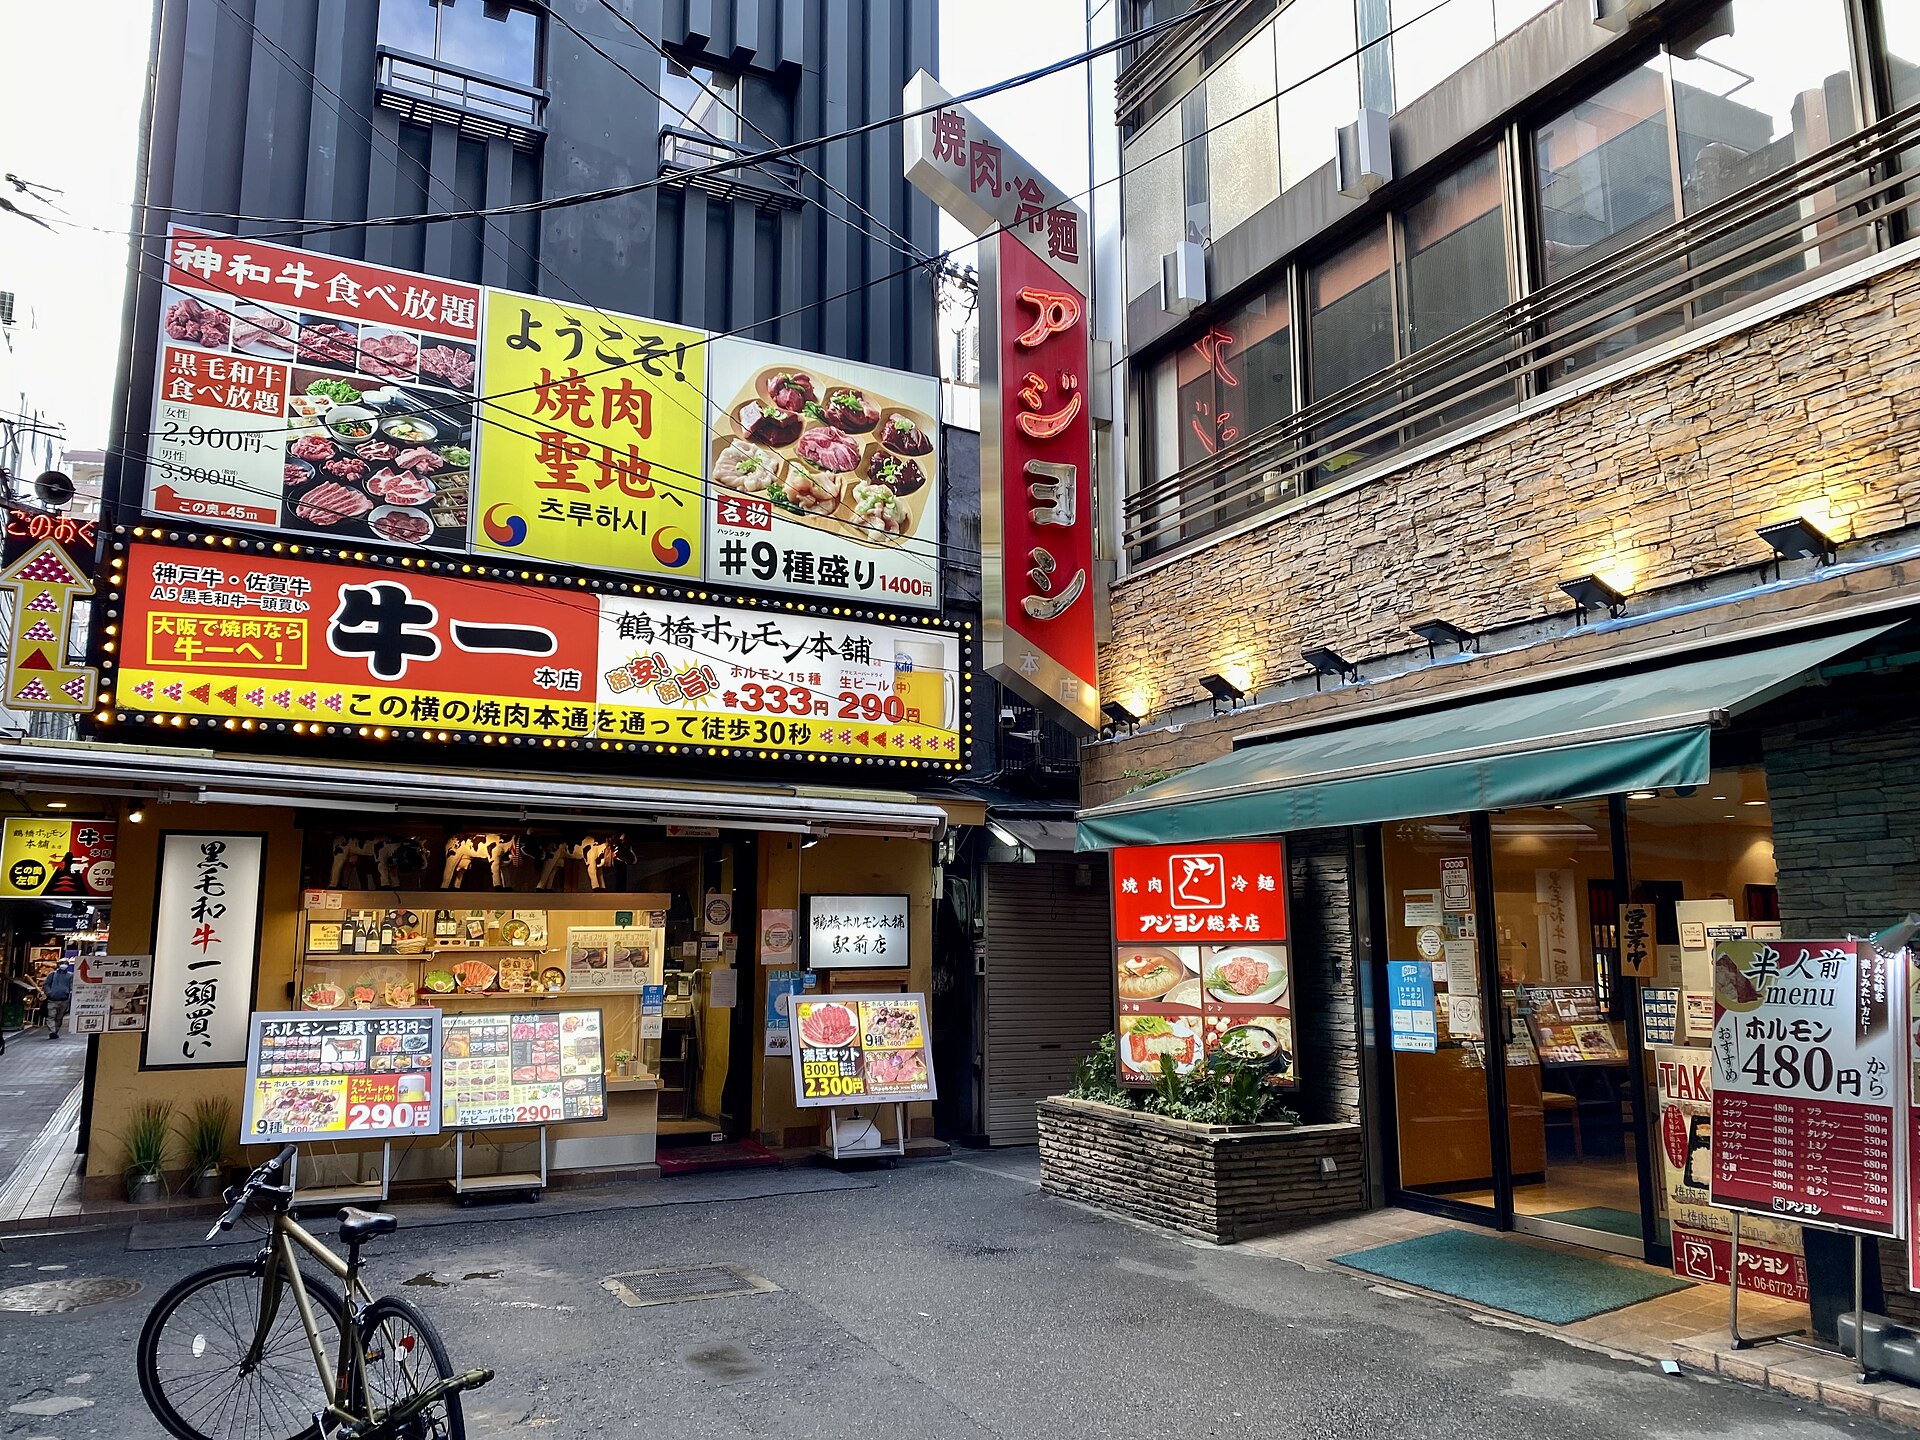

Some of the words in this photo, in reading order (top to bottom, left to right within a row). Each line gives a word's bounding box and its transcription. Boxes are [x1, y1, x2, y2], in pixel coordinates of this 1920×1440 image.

[932, 109, 1079, 264] 焼肉・冷麺
[174, 240, 475, 330] 神和牛食べ放題
[169, 350, 282, 384] 黒毛和牛
[167, 376, 280, 415] 食べ放題
[532, 367, 653, 440] 焼肉
[166, 407, 187, 419] 女性
[162, 450, 185, 462] 男性
[1014, 287, 1086, 620] アジヨシ
[534, 431, 684, 507] 聖地へ
[537, 498, 647, 535] 츠루하시
[719, 499, 769, 528] 名物
[7, 509, 96, 547] このおく
[717, 528, 751, 538] ハッシュタグ
[153, 562, 311, 597] 神戸牛・佐賀牛
[879, 575, 932, 597] 1400円
[153, 617, 302, 640] 大阪で焼肉なら
[326, 580, 557, 681] 牛一
[615, 610, 873, 666] 鶴橋ホルモン本舗
[533, 665, 582, 691] 本店
[840, 669, 883, 677] アサヒスーパードライ
[1019, 650, 1079, 702] 本店
[722, 683, 829, 717] 各333円
[838, 691, 920, 723] 290円
[349, 692, 812, 746] この横の焼肉本通を通って徒歩30秒
[14, 866, 42, 875] この奥
[15, 875, 39, 886] 左側
[1121, 877, 1163, 894] 焼肉
[1231, 873, 1276, 892] 冷麺
[812, 913, 905, 930] 鶴橋ホルモン本舗
[1140, 913, 1261, 933] アジヨシ総本店
[183, 840, 229, 1058] 黒毛和牛一頭買い
[832, 934, 888, 955] 駅前店
[1624, 908, 1649, 972] 営業中
[1744, 948, 1847, 989] 半人前
[1764, 986, 1836, 1006] menu
[1745, 1016, 1832, 1043] ホルモン
[865, 1034, 884, 1047] 9種
[803, 1048, 860, 1062] 満足セット
[1718, 1026, 1738, 1082] おすすめ
[806, 1064, 836, 1076] 300g
[1741, 1043, 1862, 1097] 480円
[1867, 1056, 1888, 1098] から
[351, 1079, 373, 1087] アサヒ
[351, 1085, 396, 1095] スーパードライ
[805, 1077, 864, 1097] 2,300円
[1659, 1062, 1712, 1102] TAK
[348, 1103, 430, 1131] 290円
[460, 1107, 515, 1115] アサヒスーパードライ
[517, 1105, 561, 1122] 290円
[1772, 1103, 1794, 1113] 480円
[1864, 1113, 1888, 1123] 500円
[256, 1119, 282, 1134] 9種
[1772, 1115, 1794, 1124] 480円
[1864, 1124, 1888, 1135] 500円
[1772, 1126, 1794, 1135] 480円
[1772, 1137, 1794, 1146] 480円
[1864, 1136, 1888, 1147] 550円
[1772, 1147, 1794, 1157] 480円
[1864, 1148, 1888, 1159] 550円
[1772, 1159, 1794, 1168] 480円
[1806, 1164, 1829, 1174] ロース
[1864, 1171, 1888, 1183] 730円
[1864, 1160, 1888, 1171] 680円
[1772, 1170, 1794, 1180] 480円
[1675, 1184, 1708, 1200] 焼肉弁
[1772, 1180, 1794, 1192] 500円
[1864, 1183, 1888, 1195] 750円
[1785, 1200, 1822, 1215] アジヨシ
[1864, 1195, 1888, 1207] 780円
[1737, 1252, 1788, 1275] アジヨシ
